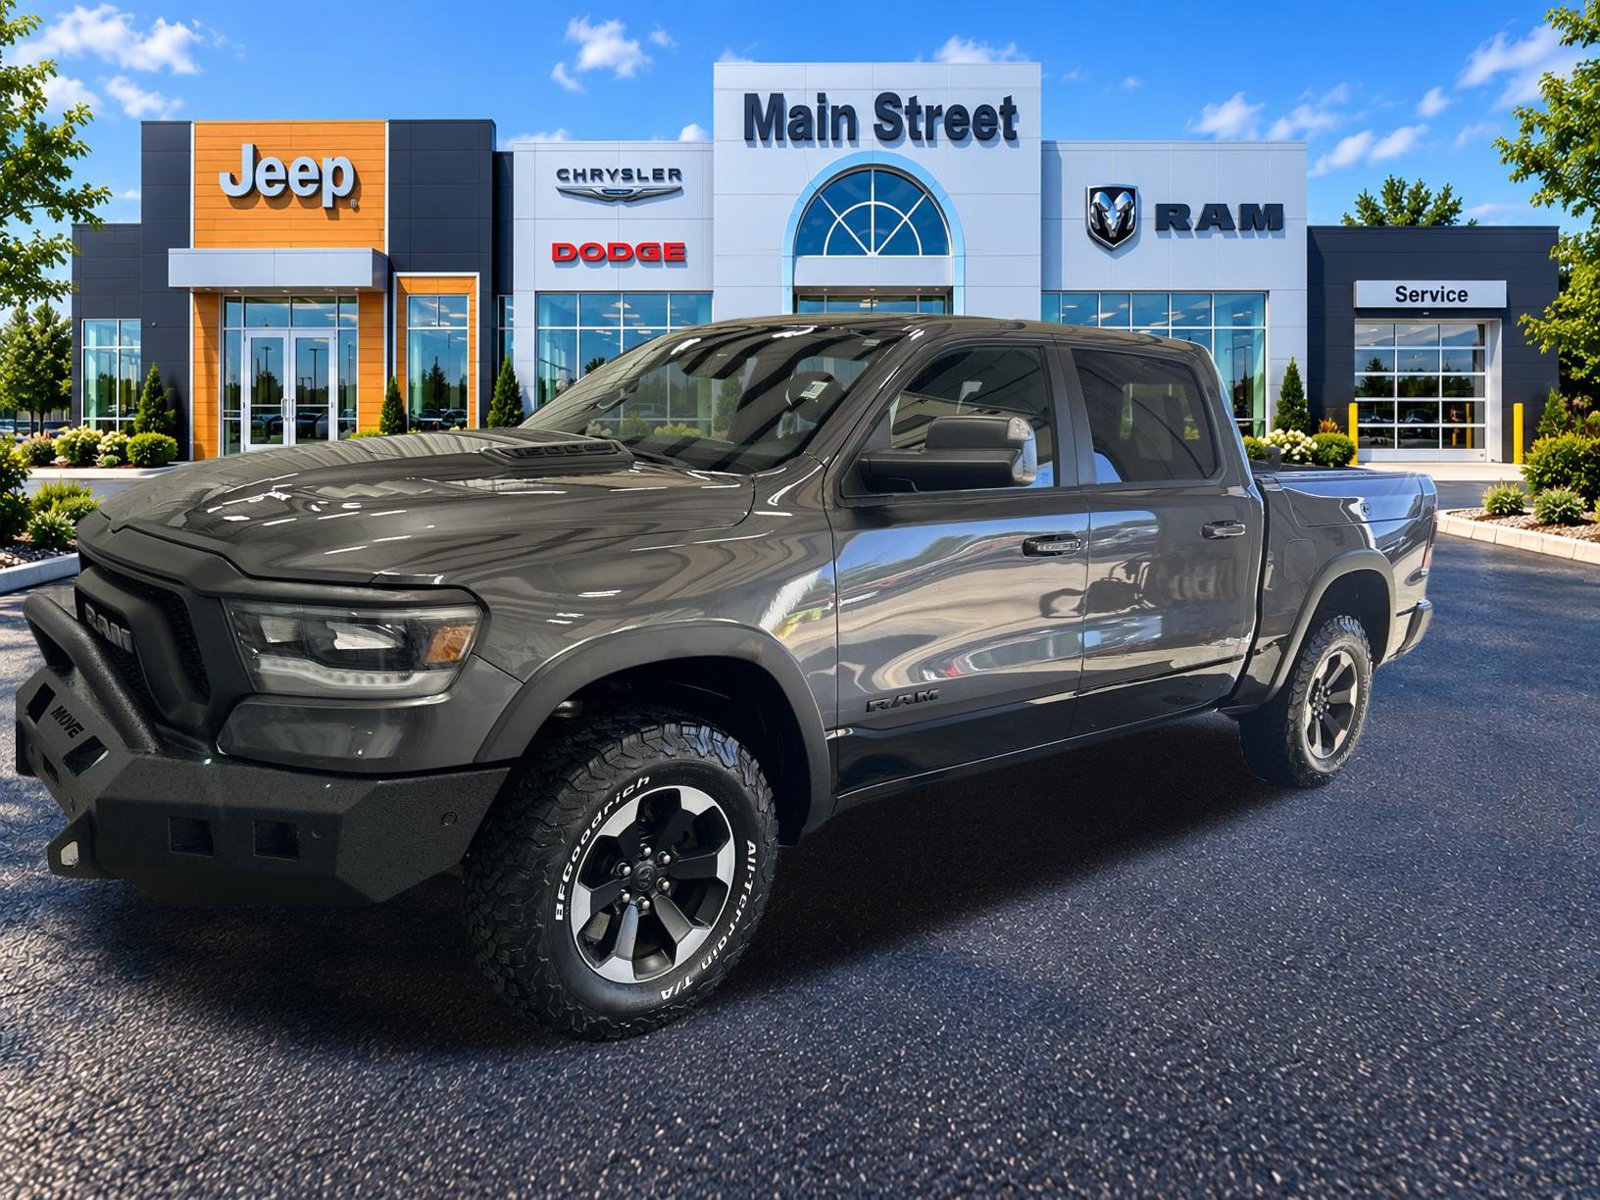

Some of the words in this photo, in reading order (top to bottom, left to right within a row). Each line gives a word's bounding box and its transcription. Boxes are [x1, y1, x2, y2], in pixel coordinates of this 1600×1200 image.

[744, 92, 856, 142] Main
[874, 92, 1018, 142] Street
[556, 167, 682, 183] CHRYSLER
[1155, 203, 1284, 232] RAM
[551, 241, 687, 263] DODGE
[1395, 285, 1469, 303] Service
[866, 688, 940, 713] RAM
[50, 705, 85, 739] MOVE
[555, 775, 651, 921] BFGoodrich
[701, 839, 757, 971] All-Terrain
[660, 975, 694, 1001] T/A
